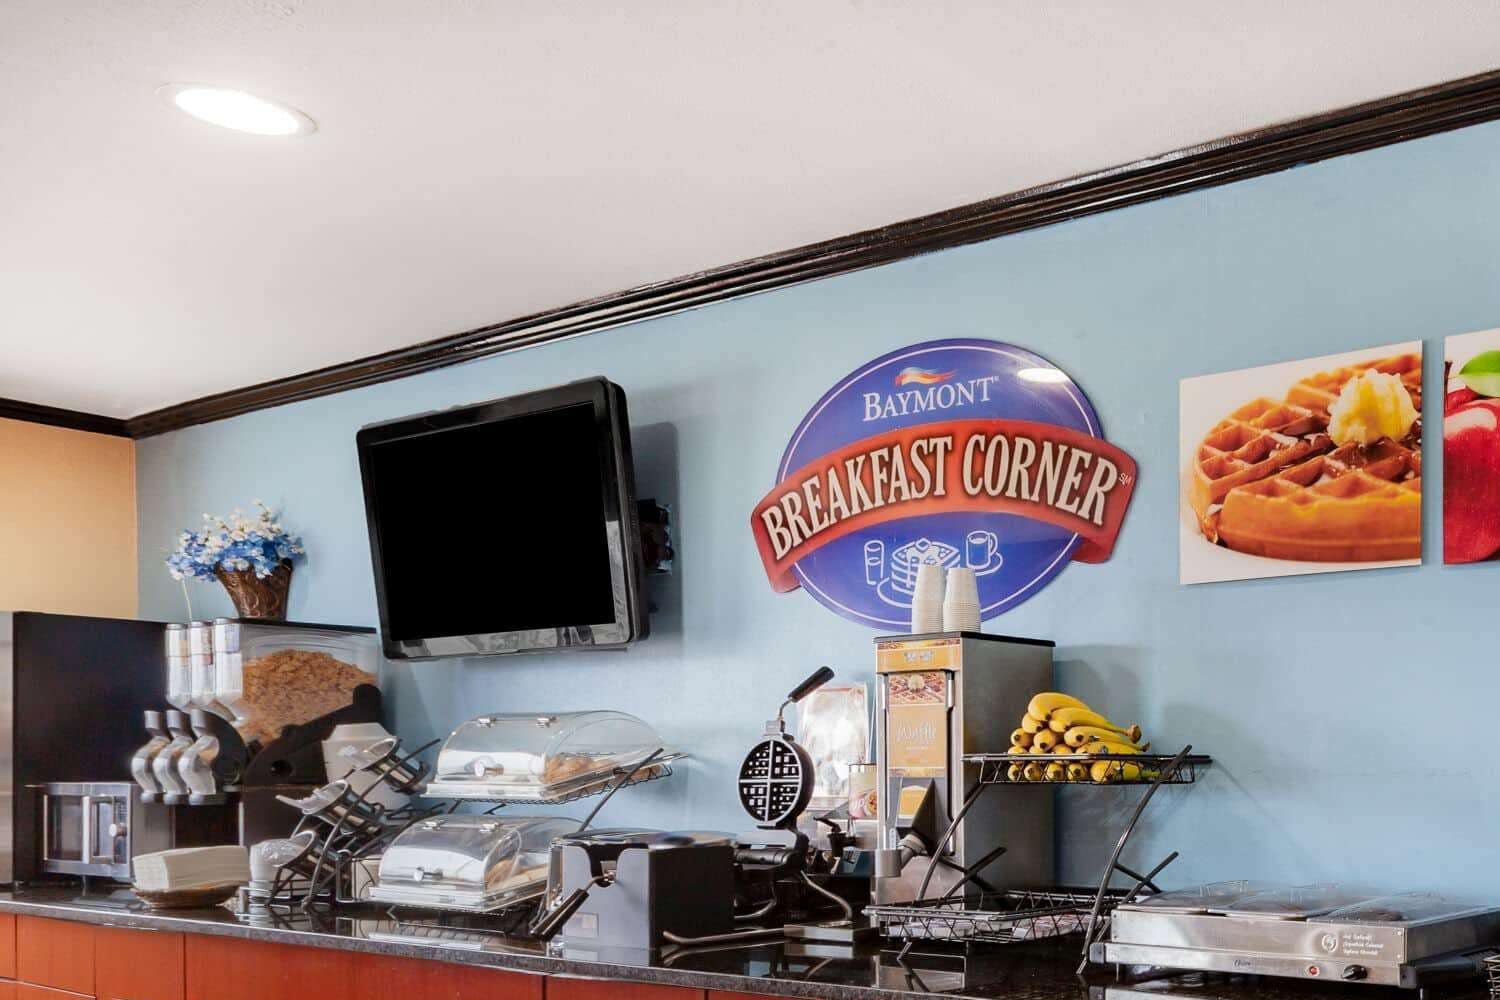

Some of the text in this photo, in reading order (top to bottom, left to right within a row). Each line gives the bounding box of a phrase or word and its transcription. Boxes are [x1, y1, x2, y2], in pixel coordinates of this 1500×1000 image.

[863, 376, 994, 421] BAYMONT
[761, 436, 953, 560] BREAKFAST
[962, 434, 1118, 526] CORNER
